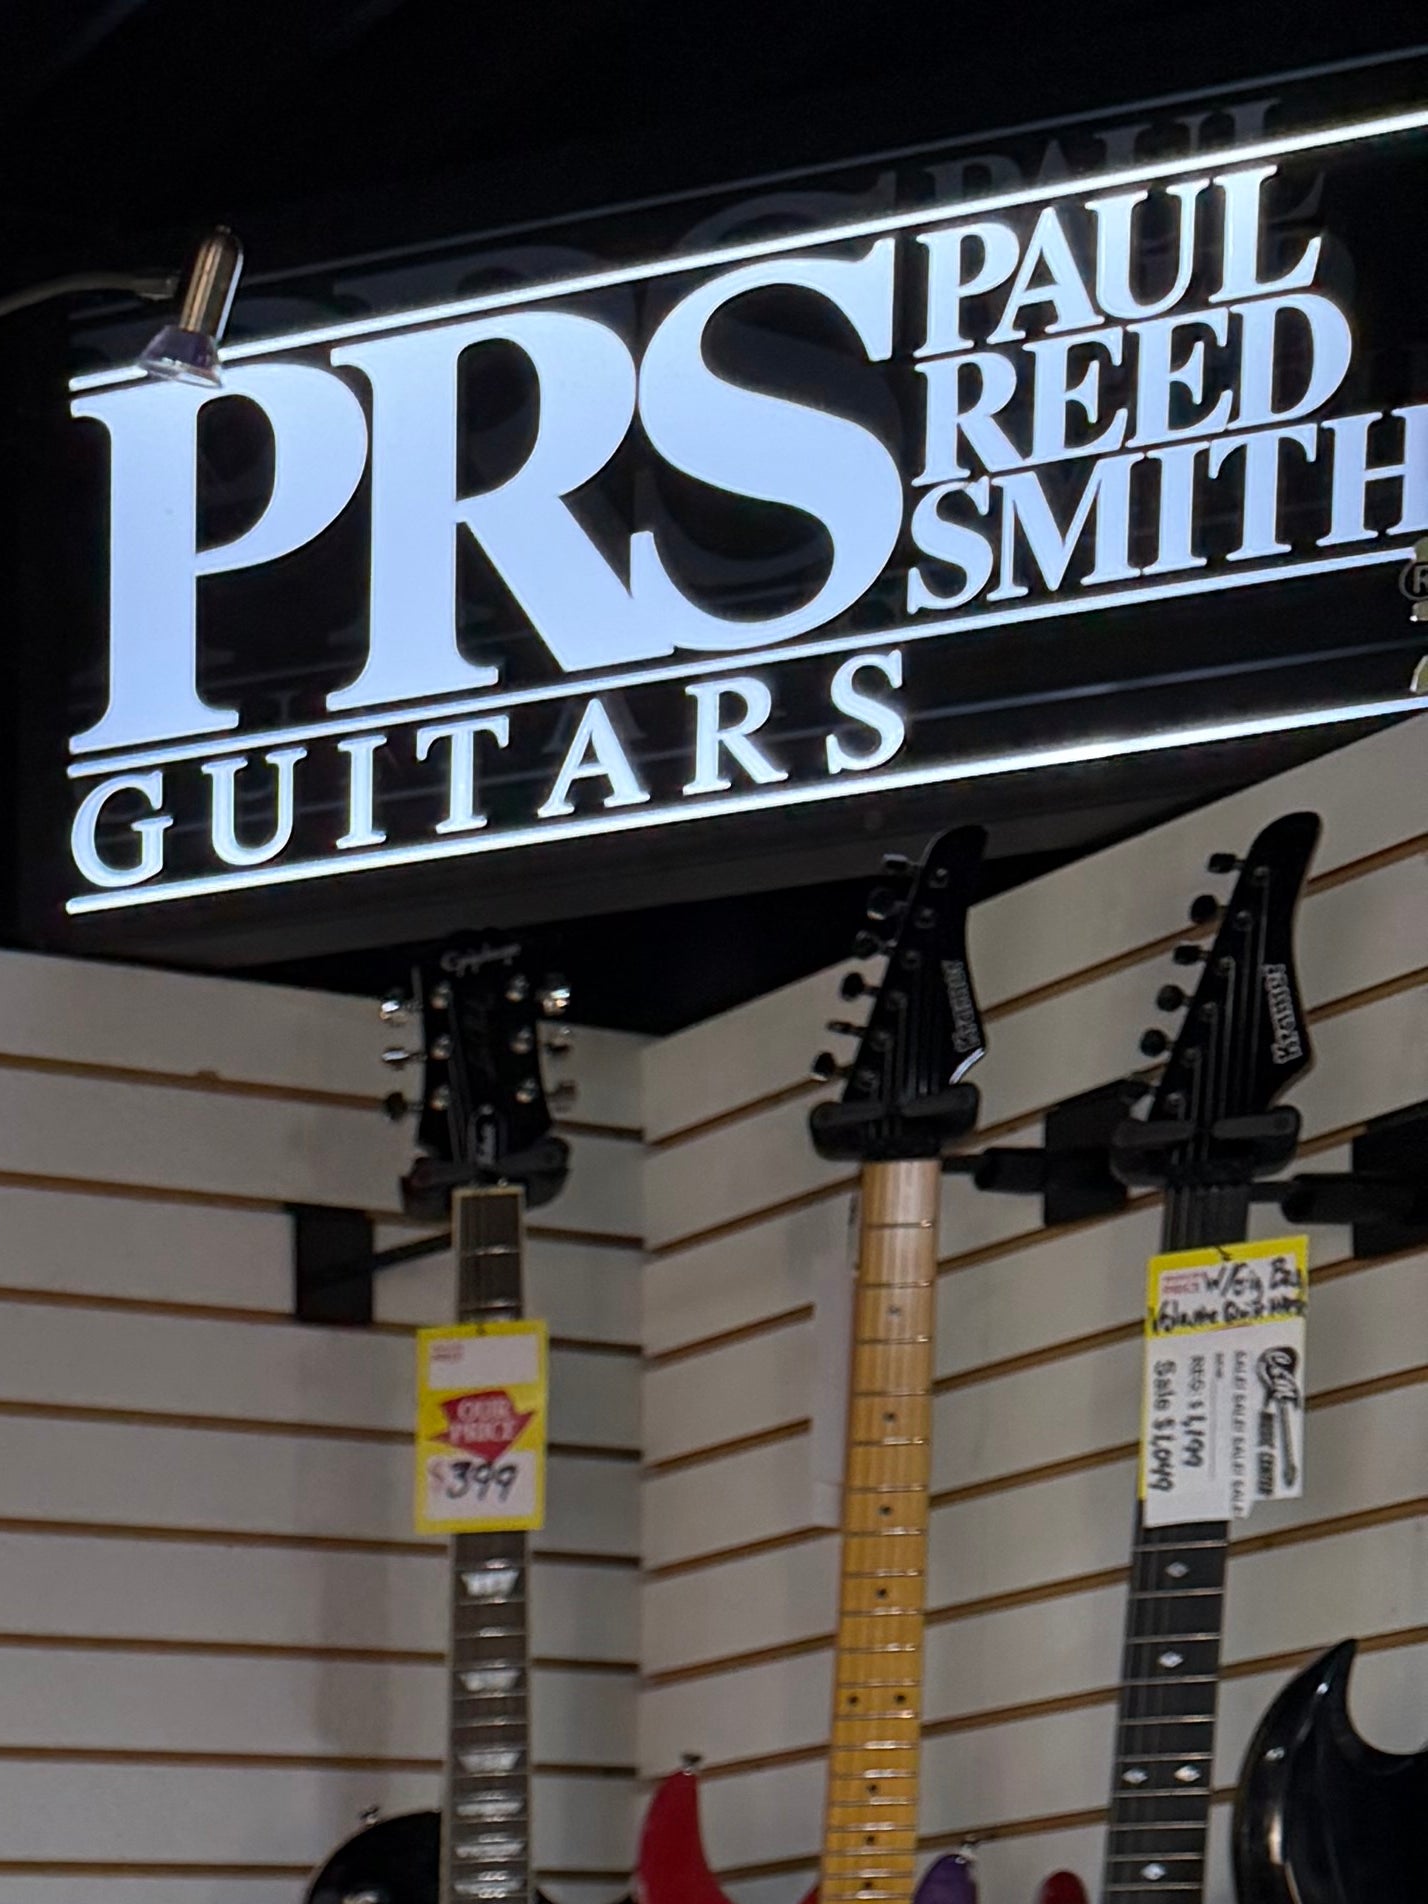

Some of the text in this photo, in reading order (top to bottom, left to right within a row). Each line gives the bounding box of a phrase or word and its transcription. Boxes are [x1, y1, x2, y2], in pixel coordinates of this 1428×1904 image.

[913, 164, 1324, 358] PAUL
[912, 292, 1353, 487] REED
[69, 238, 904, 754] PRS
[906, 406, 1428, 616] SMITH
[69, 648, 907, 888] GUITARS
